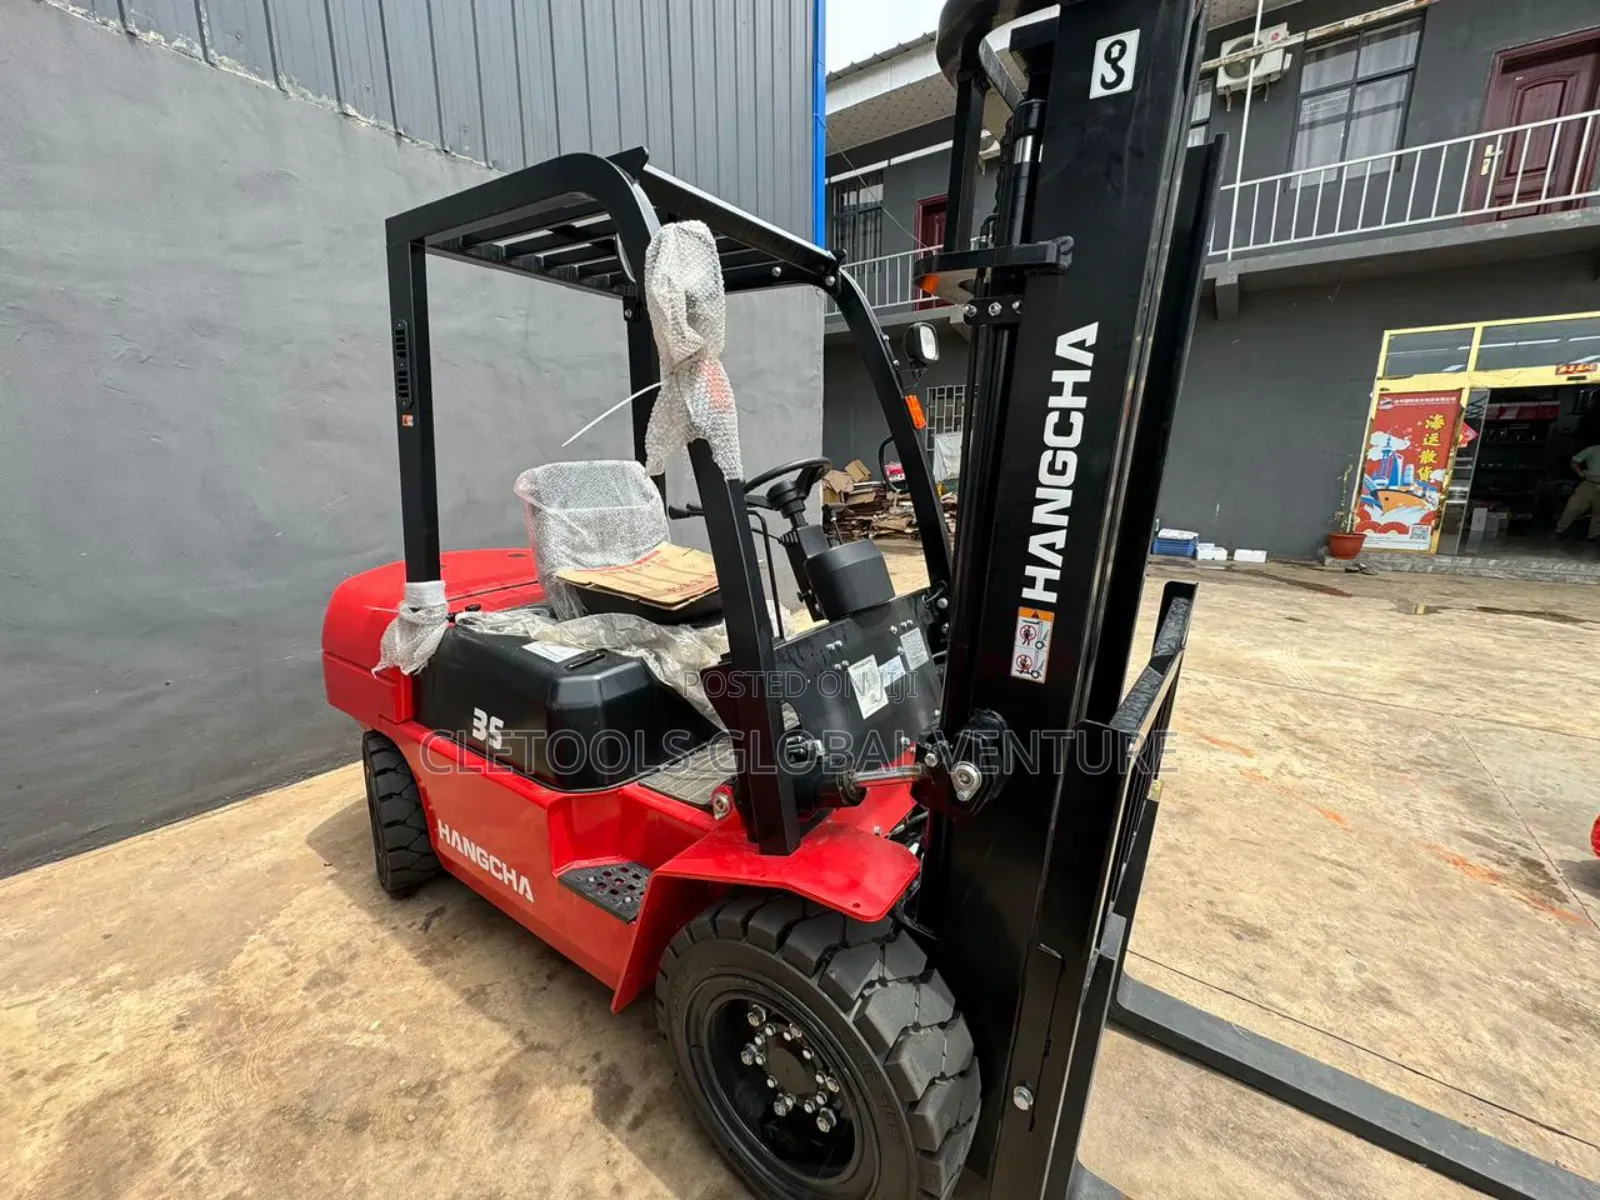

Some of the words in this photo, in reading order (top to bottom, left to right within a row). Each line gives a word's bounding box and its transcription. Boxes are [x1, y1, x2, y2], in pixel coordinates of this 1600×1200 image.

[1021, 321, 1099, 604] HANGCHA
[1416, 414, 1445, 482] 海运散货
[471, 707, 505, 750] 35
[436, 819, 535, 903] HANGCHA
